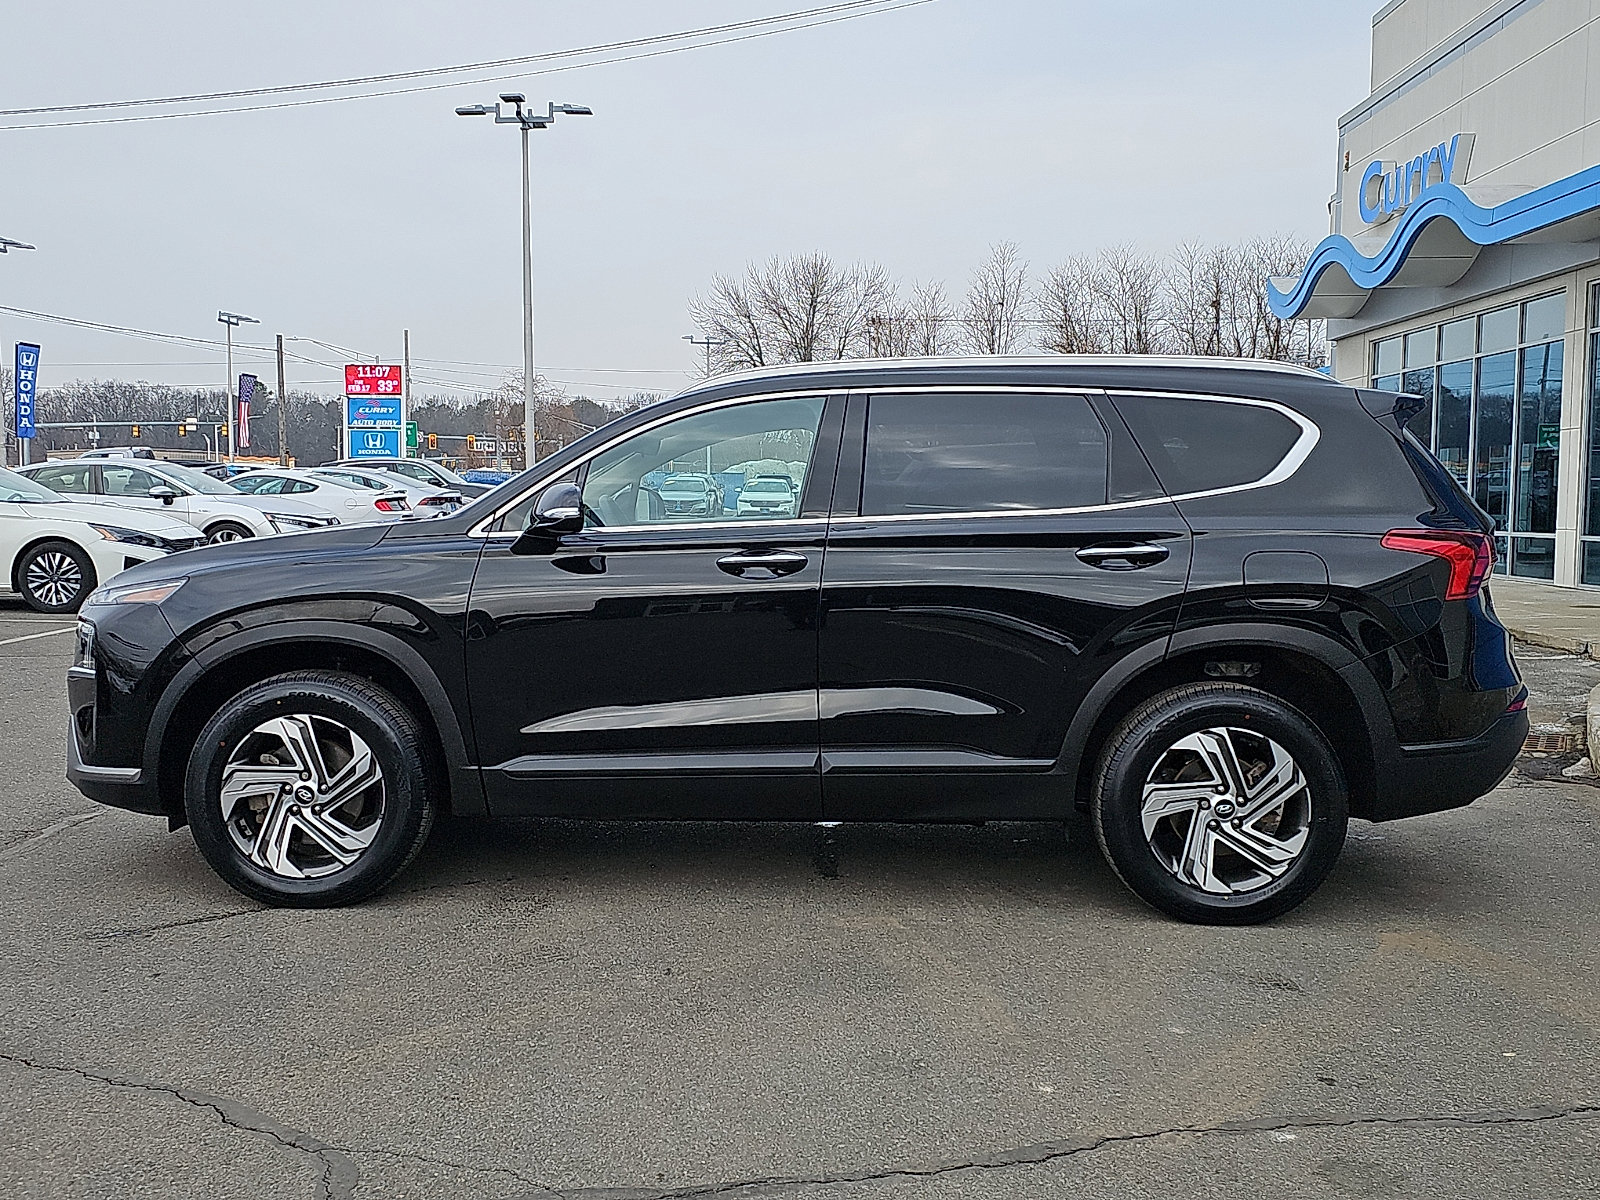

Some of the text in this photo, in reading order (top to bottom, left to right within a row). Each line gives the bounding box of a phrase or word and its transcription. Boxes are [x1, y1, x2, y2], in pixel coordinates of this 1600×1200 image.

[1359, 133, 1466, 224] Curry
[19, 370, 34, 428] HONDA
[358, 366, 390, 378] 11:07
